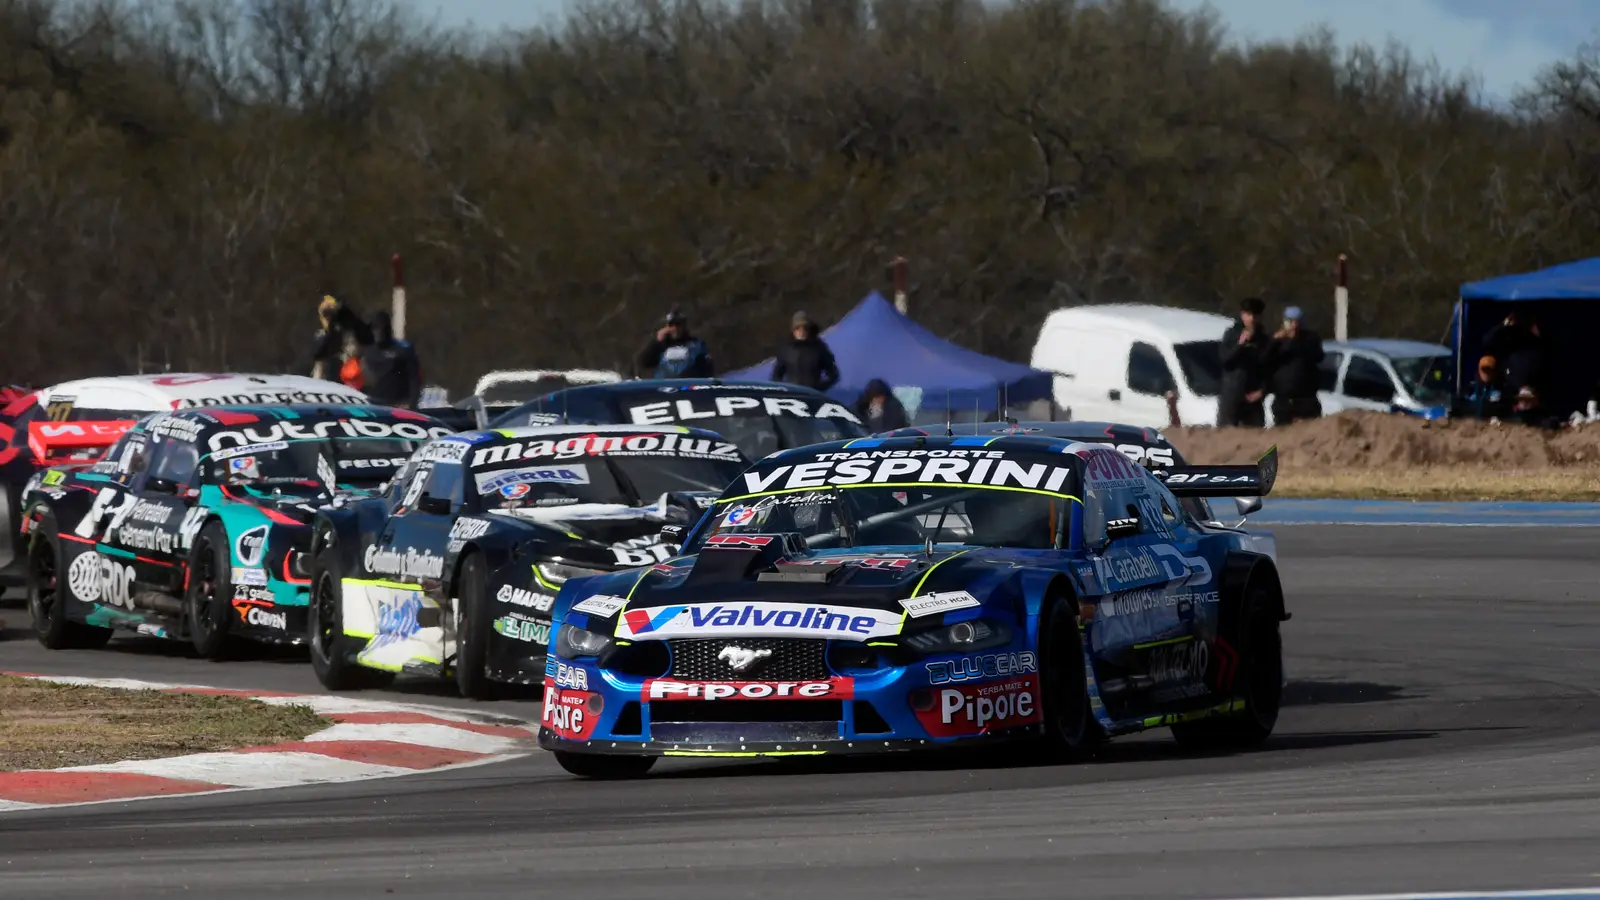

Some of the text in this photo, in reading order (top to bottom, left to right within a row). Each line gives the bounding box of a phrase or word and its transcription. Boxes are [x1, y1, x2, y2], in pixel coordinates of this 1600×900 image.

[629, 396, 864, 426] ELPRA
[470, 433, 740, 467] magnoluz
[815, 450, 1005, 462] TRANSPORTE
[481, 467, 582, 491] SIERRA
[743, 458, 1070, 494] VESPRINI
[750, 488, 844, 513] Catedra
[1106, 545, 1160, 583] Carabelli
[101, 558, 136, 611] RDC
[909, 595, 970, 611] ELECTRO HCM
[690, 605, 877, 635] Valvoline
[925, 651, 1037, 685] BLUECAR
[650, 680, 832, 700] Pipore
[977, 681, 1023, 696] YERBA MATE
[941, 689, 1034, 728] Pipore
